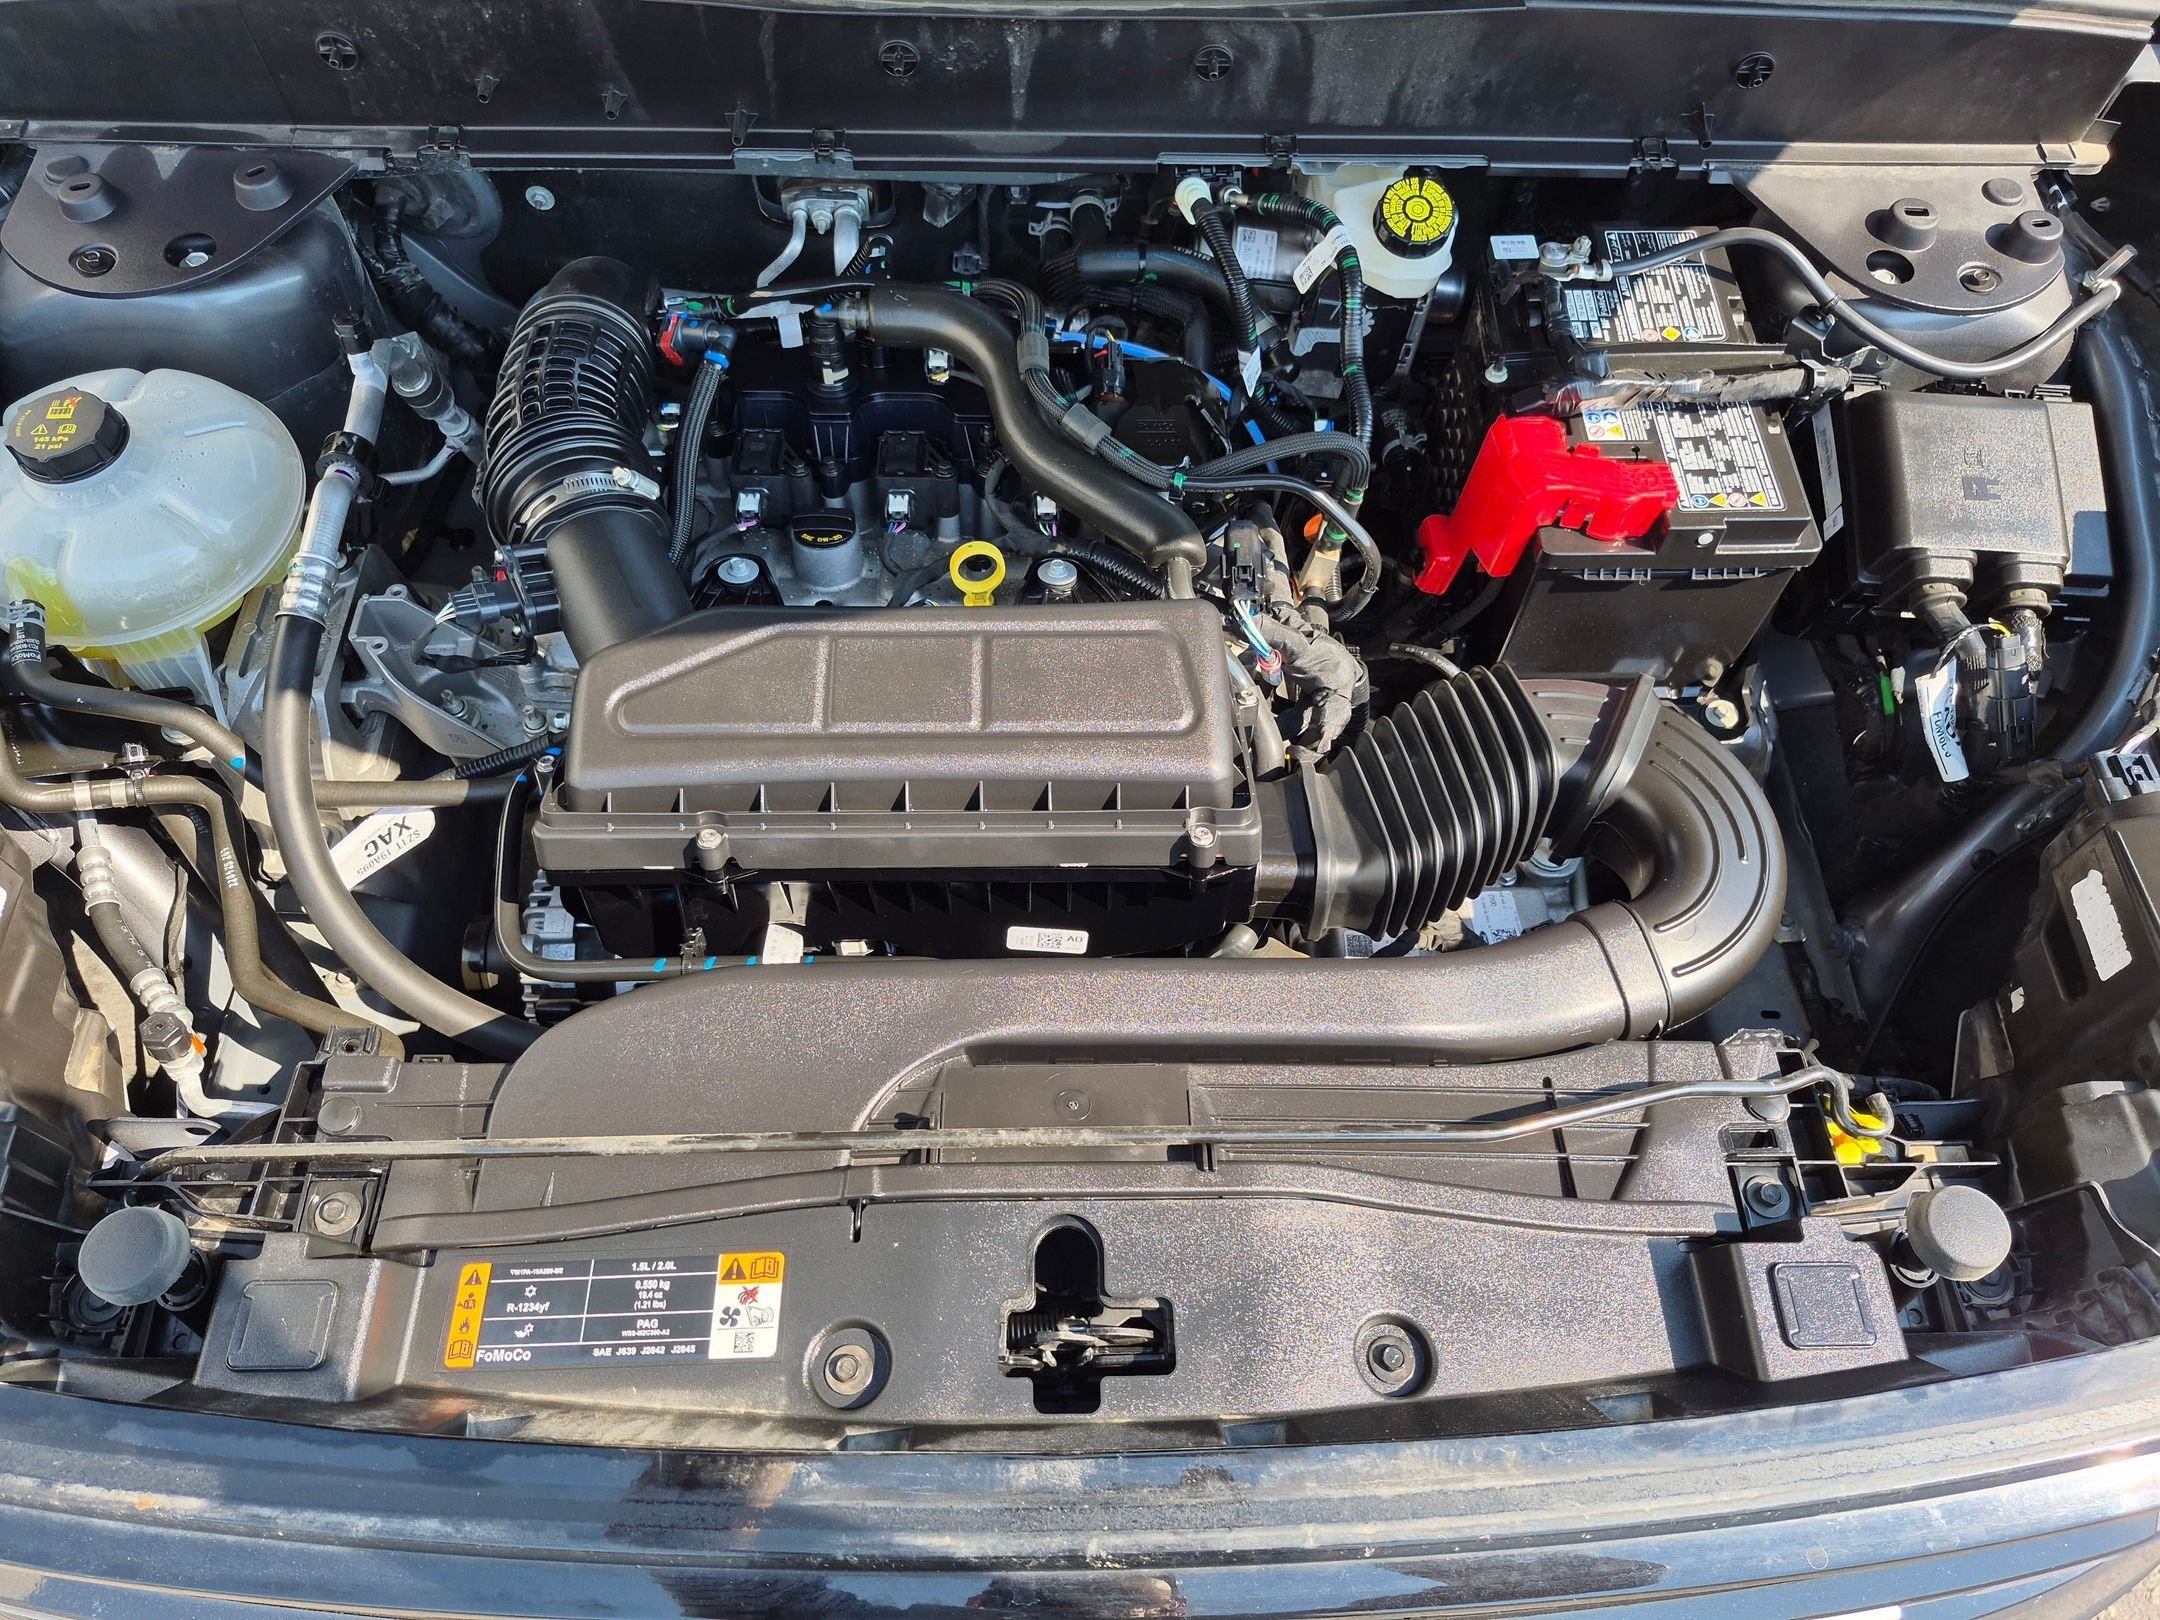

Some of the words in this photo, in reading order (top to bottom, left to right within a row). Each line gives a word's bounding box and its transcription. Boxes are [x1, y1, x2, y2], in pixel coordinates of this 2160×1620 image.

[801, 533, 815, 542] SAE
[817, 534, 843, 543] 0W-20
[11, 651, 40, 663] FoMoCo
[364, 815, 412, 858] XAC
[356, 849, 392, 876] 19A095
[1066, 935, 1083, 943] AD
[632, 1262, 651, 1271] 1.5L
[657, 1261, 677, 1271] 2.0L
[635, 1279, 658, 1290] 0.550
[659, 1279, 671, 1291] kg
[638, 1291, 653, 1299] 19.4
[653, 1291, 663, 1299] oz
[506, 1301, 551, 1314] R-1234yf
[634, 1301, 651, 1311] (1.21
[652, 1300, 667, 1310] lbs)
[636, 1319, 659, 1329] PAG
[476, 1347, 532, 1363] FoMoCo
[592, 1346, 612, 1357] SAE
[616, 1346, 637, 1357] J639
[640, 1345, 665, 1356] J2842
[670, 1345, 696, 1355] J2845
